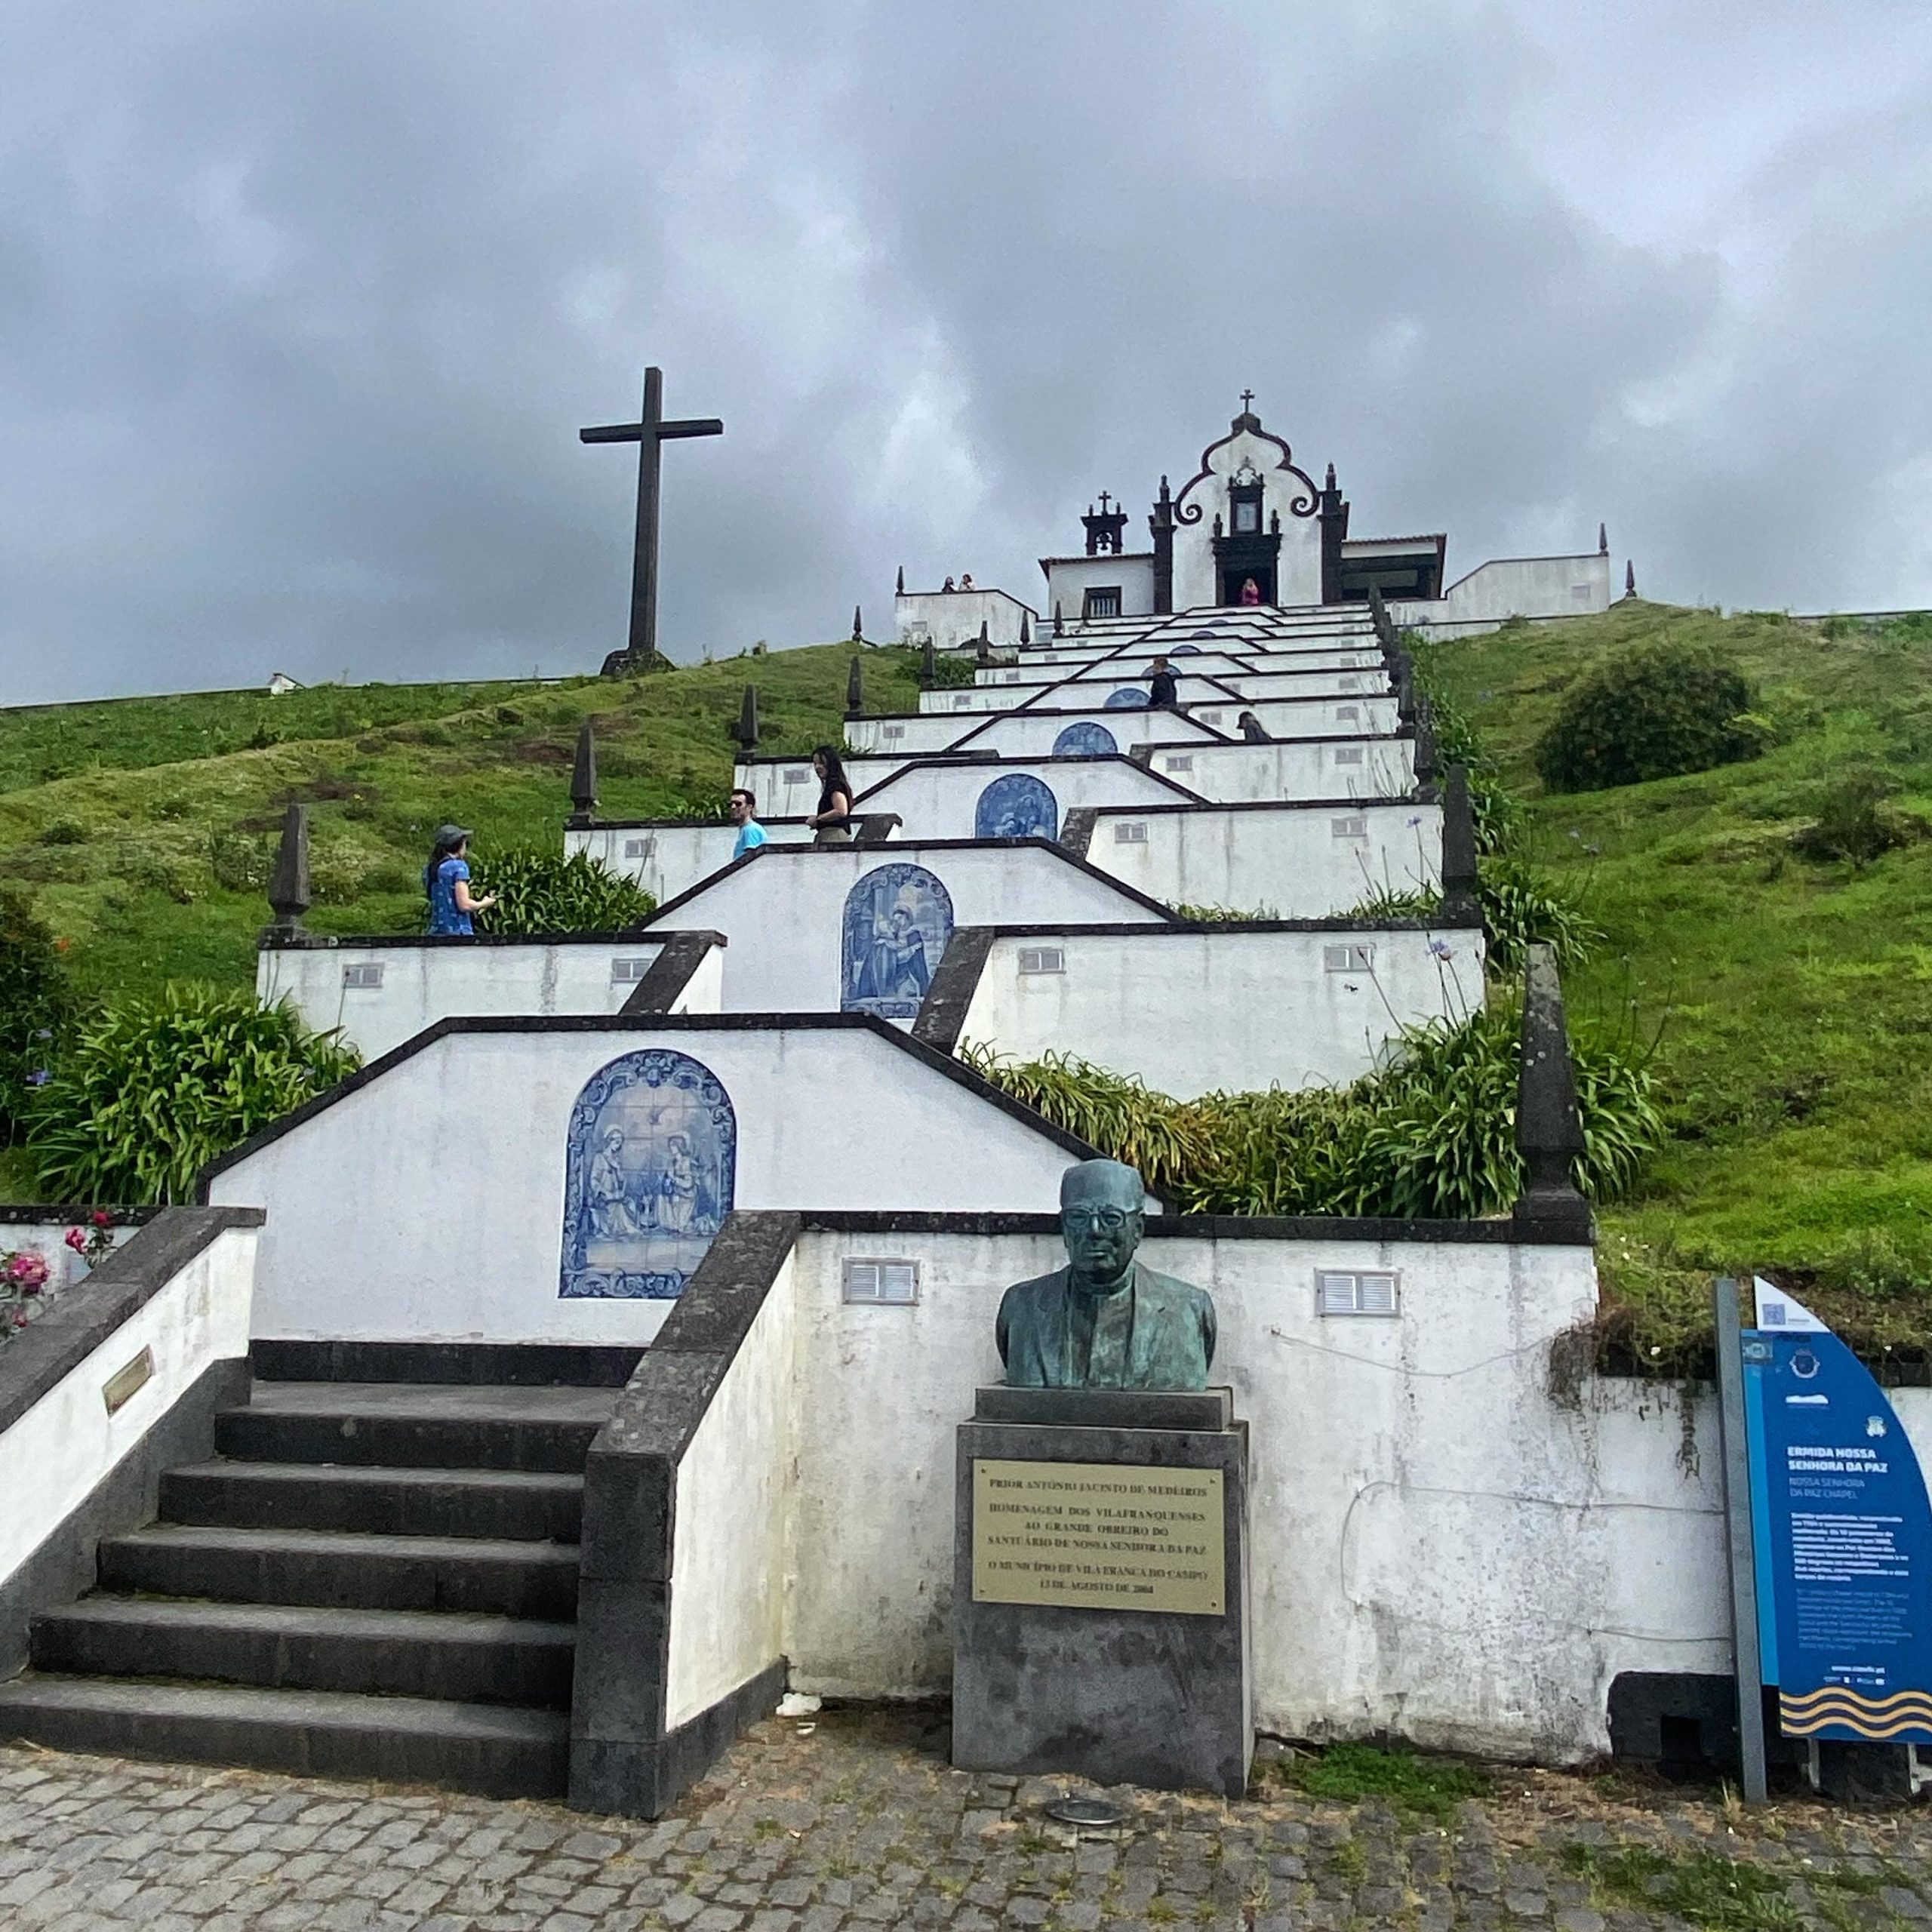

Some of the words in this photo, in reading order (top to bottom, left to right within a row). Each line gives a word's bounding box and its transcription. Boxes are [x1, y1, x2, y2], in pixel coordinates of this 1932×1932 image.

[1787, 1446, 1834, 1457] ERMIDA
[1835, 1447, 1877, 1459] NOSSA
[1789, 1460, 1844, 1471] SENHORA
[1846, 1461, 1863, 1472] DA
[1864, 1462, 1888, 1473] PAZ
[989, 1478, 1023, 1489] PRIOR
[1079, 1482, 1127, 1494] JACINTO
[1130, 1484, 1144, 1494] DE
[1148, 1486, 1208, 1497] MEDEIROS
[1789, 1477, 1820, 1487] NOSSA
[1821, 1478, 1865, 1487] SENHORA
[989, 1503, 1063, 1515] HOMENAGEM
[1069, 1507, 1091, 1516] DOS
[1025, 1521, 1041, 1531] AO
[1045, 1522, 1092, 1533] GRANDE
[1152, 1527, 1169, 1537] DO
[987, 1535, 1053, 1548] SANTUÁRIO
[1054, 1538, 1069, 1548] DE
[1072, 1540, 1108, 1550] NOSSA
[1110, 1541, 1164, 1553] SENHORA
[1167, 1544, 1183, 1554] DA
[1185, 1546, 1207, 1555] PAZ
[988, 1561, 997, 1570] O
[1058, 1564, 1073, 1573] DE
[1075, 1564, 1100, 1574] VILA
[1149, 1568, 1165, 1577] DO
[1052, 1580, 1067, 1589] DE
[1071, 1582, 1114, 1592] AGOSTO
[1115, 1583, 1130, 1592] DE
